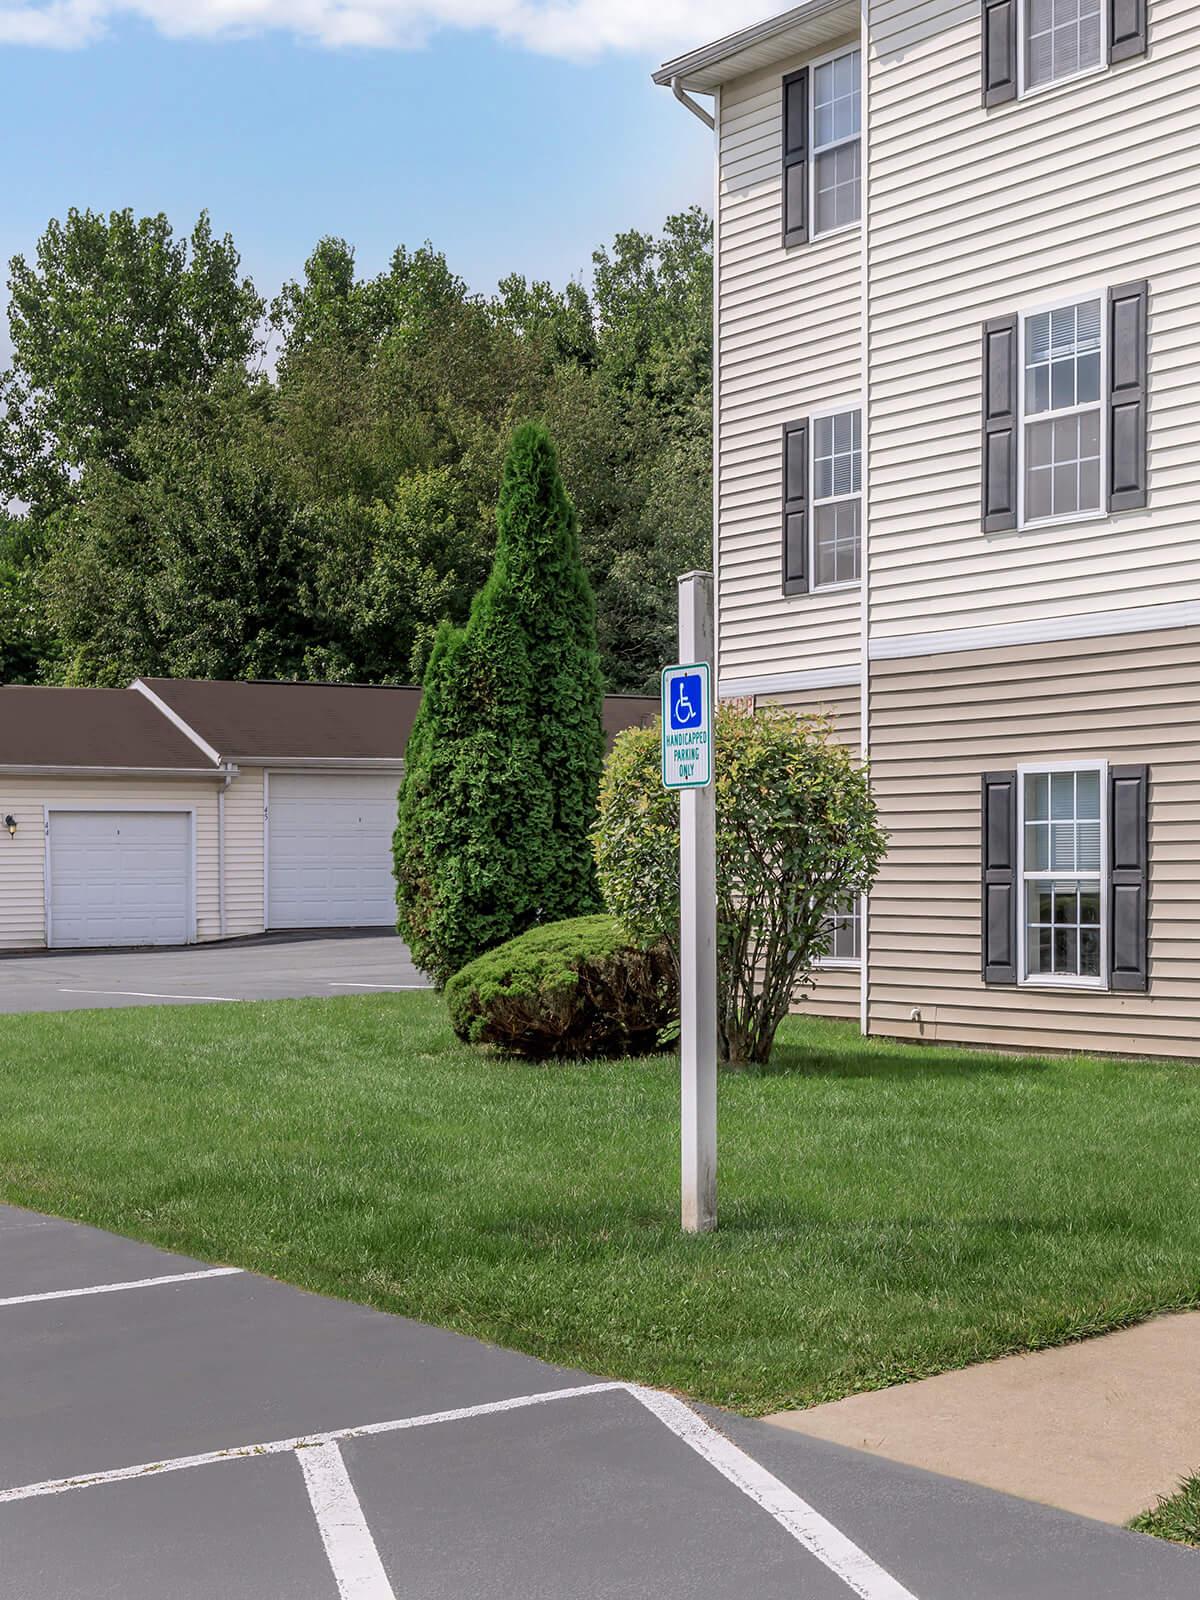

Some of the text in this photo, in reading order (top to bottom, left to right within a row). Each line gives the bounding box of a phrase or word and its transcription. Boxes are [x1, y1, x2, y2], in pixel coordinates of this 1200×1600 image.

[666, 731, 707, 746] HANDICAPPED
[674, 747, 699, 761] PARKING
[679, 763, 695, 777] ONLY
